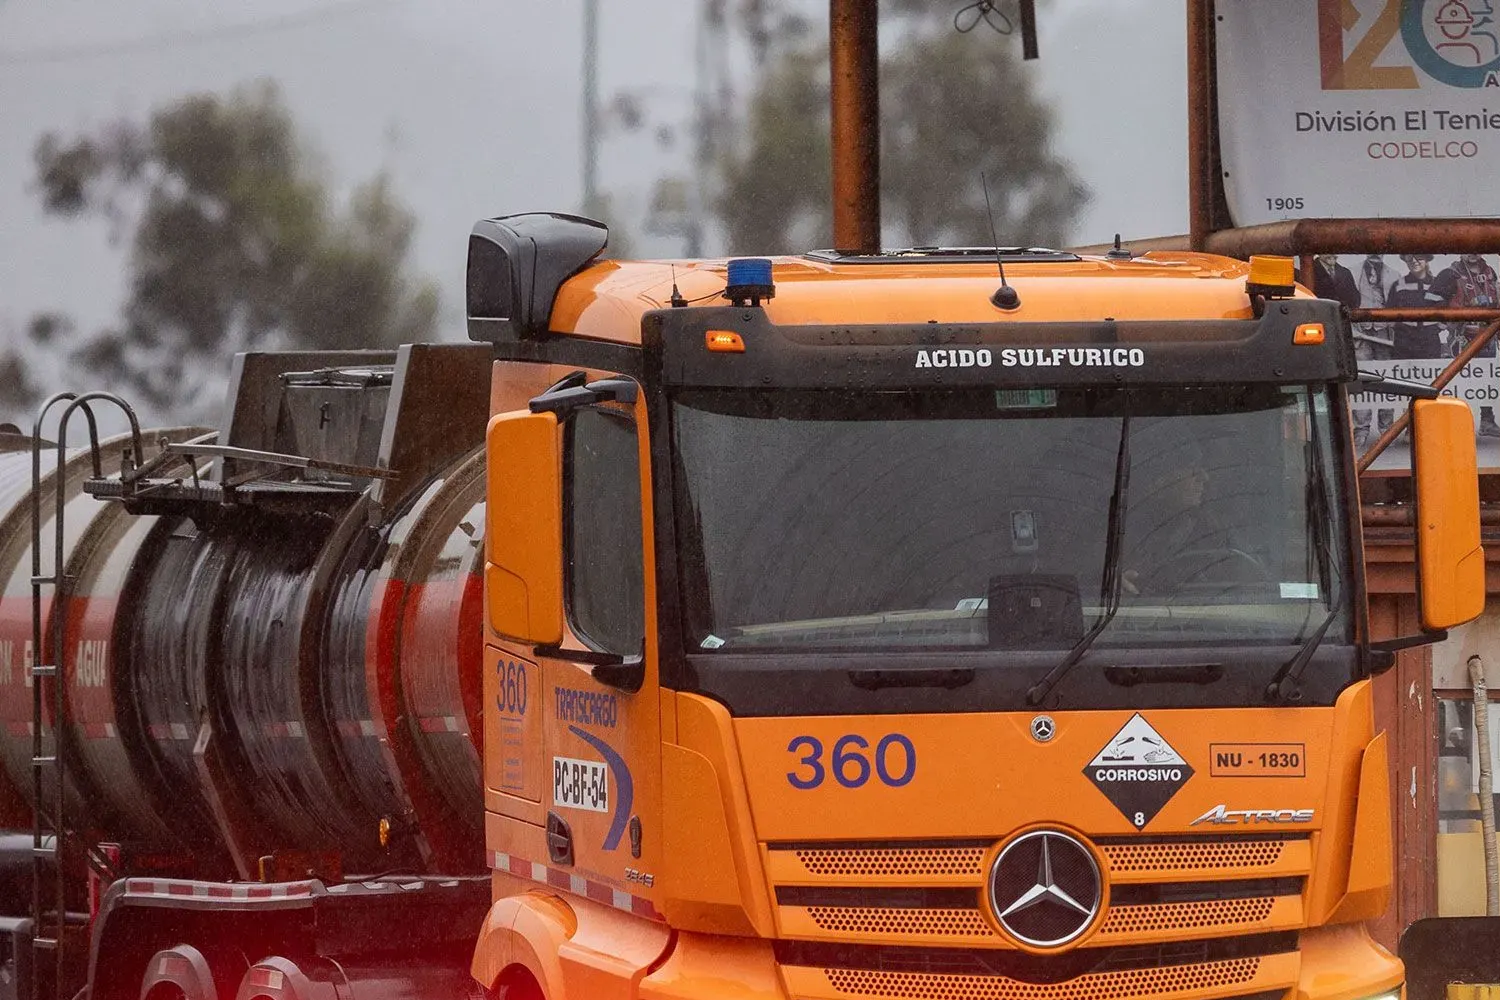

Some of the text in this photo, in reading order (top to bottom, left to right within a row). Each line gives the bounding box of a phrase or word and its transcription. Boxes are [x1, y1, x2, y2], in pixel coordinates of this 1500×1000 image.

[1296, 111, 1396, 132] División
[1404, 110, 1427, 131] El
[1367, 141, 1479, 160] CODELCO
[1266, 197, 1304, 211] 1905
[915, 348, 1145, 368] ACIDO SULFURICO
[1392, 364, 1442, 380] futur
[1460, 364, 1484, 378] de
[496, 659, 527, 716] 360
[786, 733, 917, 790] 360
[1216, 753, 1242, 768] NU
[1258, 753, 1300, 768] 1830
[554, 759, 608, 810] PC-BF-54
[1095, 769, 1182, 782] CORROSIVO
[1134, 811, 1145, 826] 8
